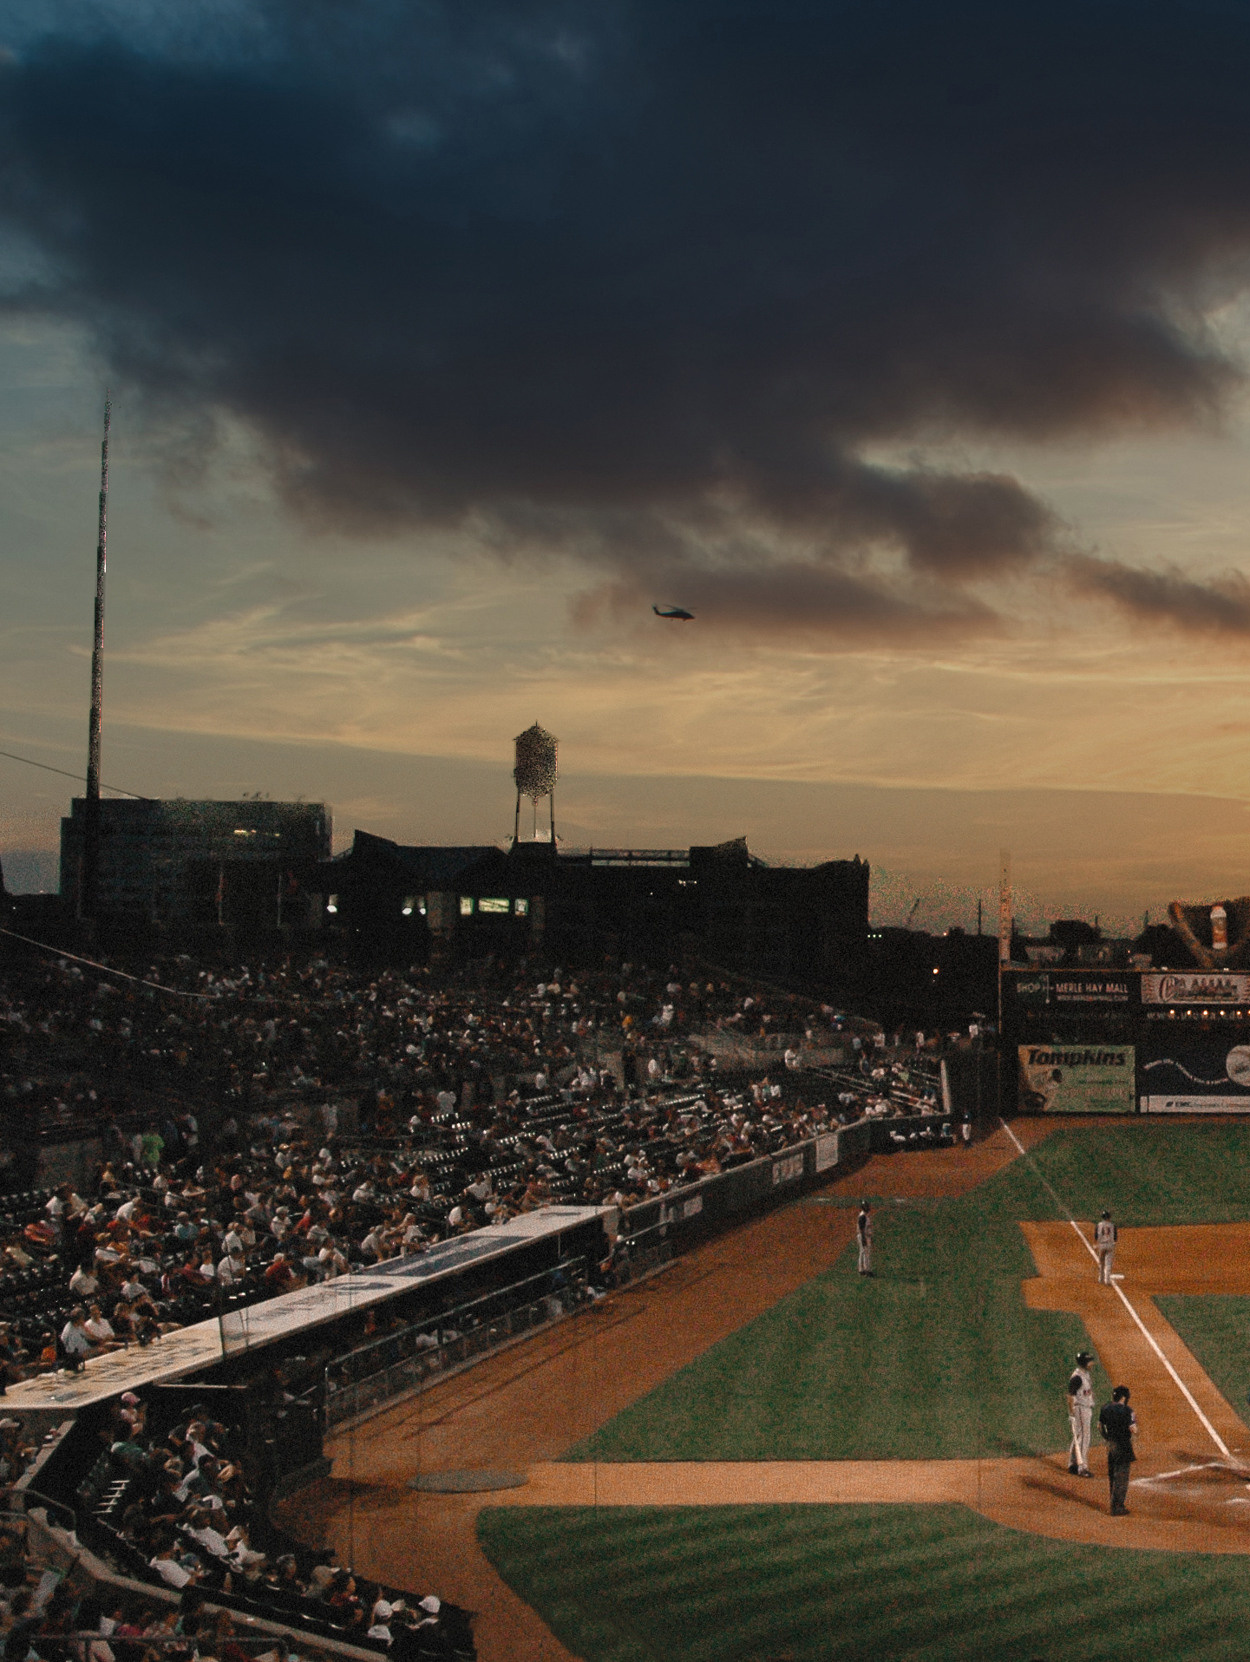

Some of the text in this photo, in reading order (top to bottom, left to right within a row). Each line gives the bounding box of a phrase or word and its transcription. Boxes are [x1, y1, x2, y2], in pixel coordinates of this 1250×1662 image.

[1055, 982, 1129, 994] MERLE HAY MALL
[1028, 1049, 1125, 1068] Tompkins
